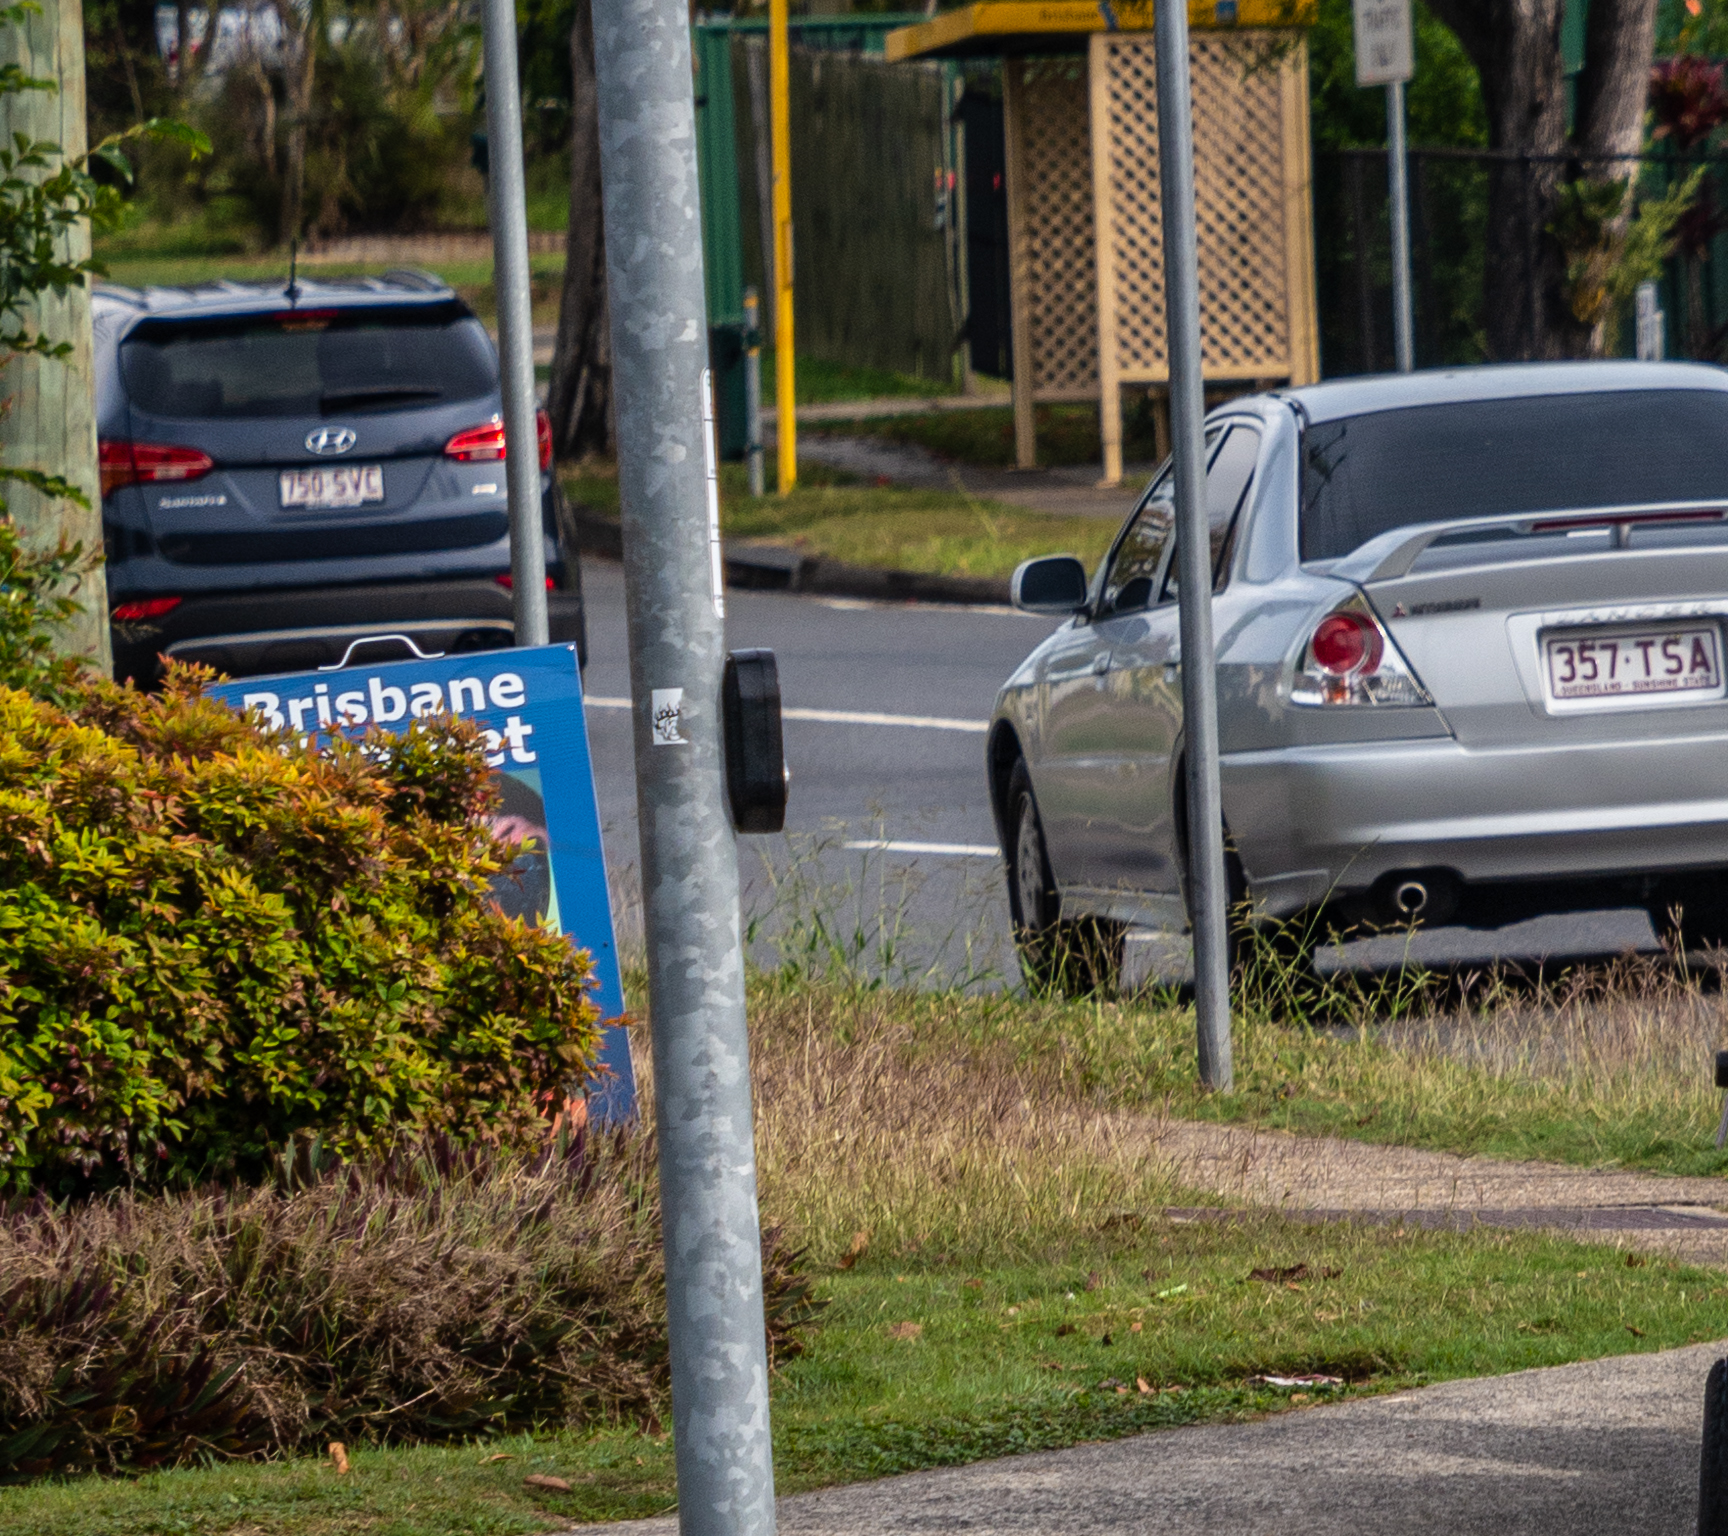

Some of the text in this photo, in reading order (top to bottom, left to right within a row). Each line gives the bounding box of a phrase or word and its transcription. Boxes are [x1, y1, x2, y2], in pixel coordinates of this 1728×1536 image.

[243, 672, 526, 734] Brisbane
[1561, 681, 1622, 696] QUEENSLAND
[1632, 678, 1678, 690] SUNSHINE
